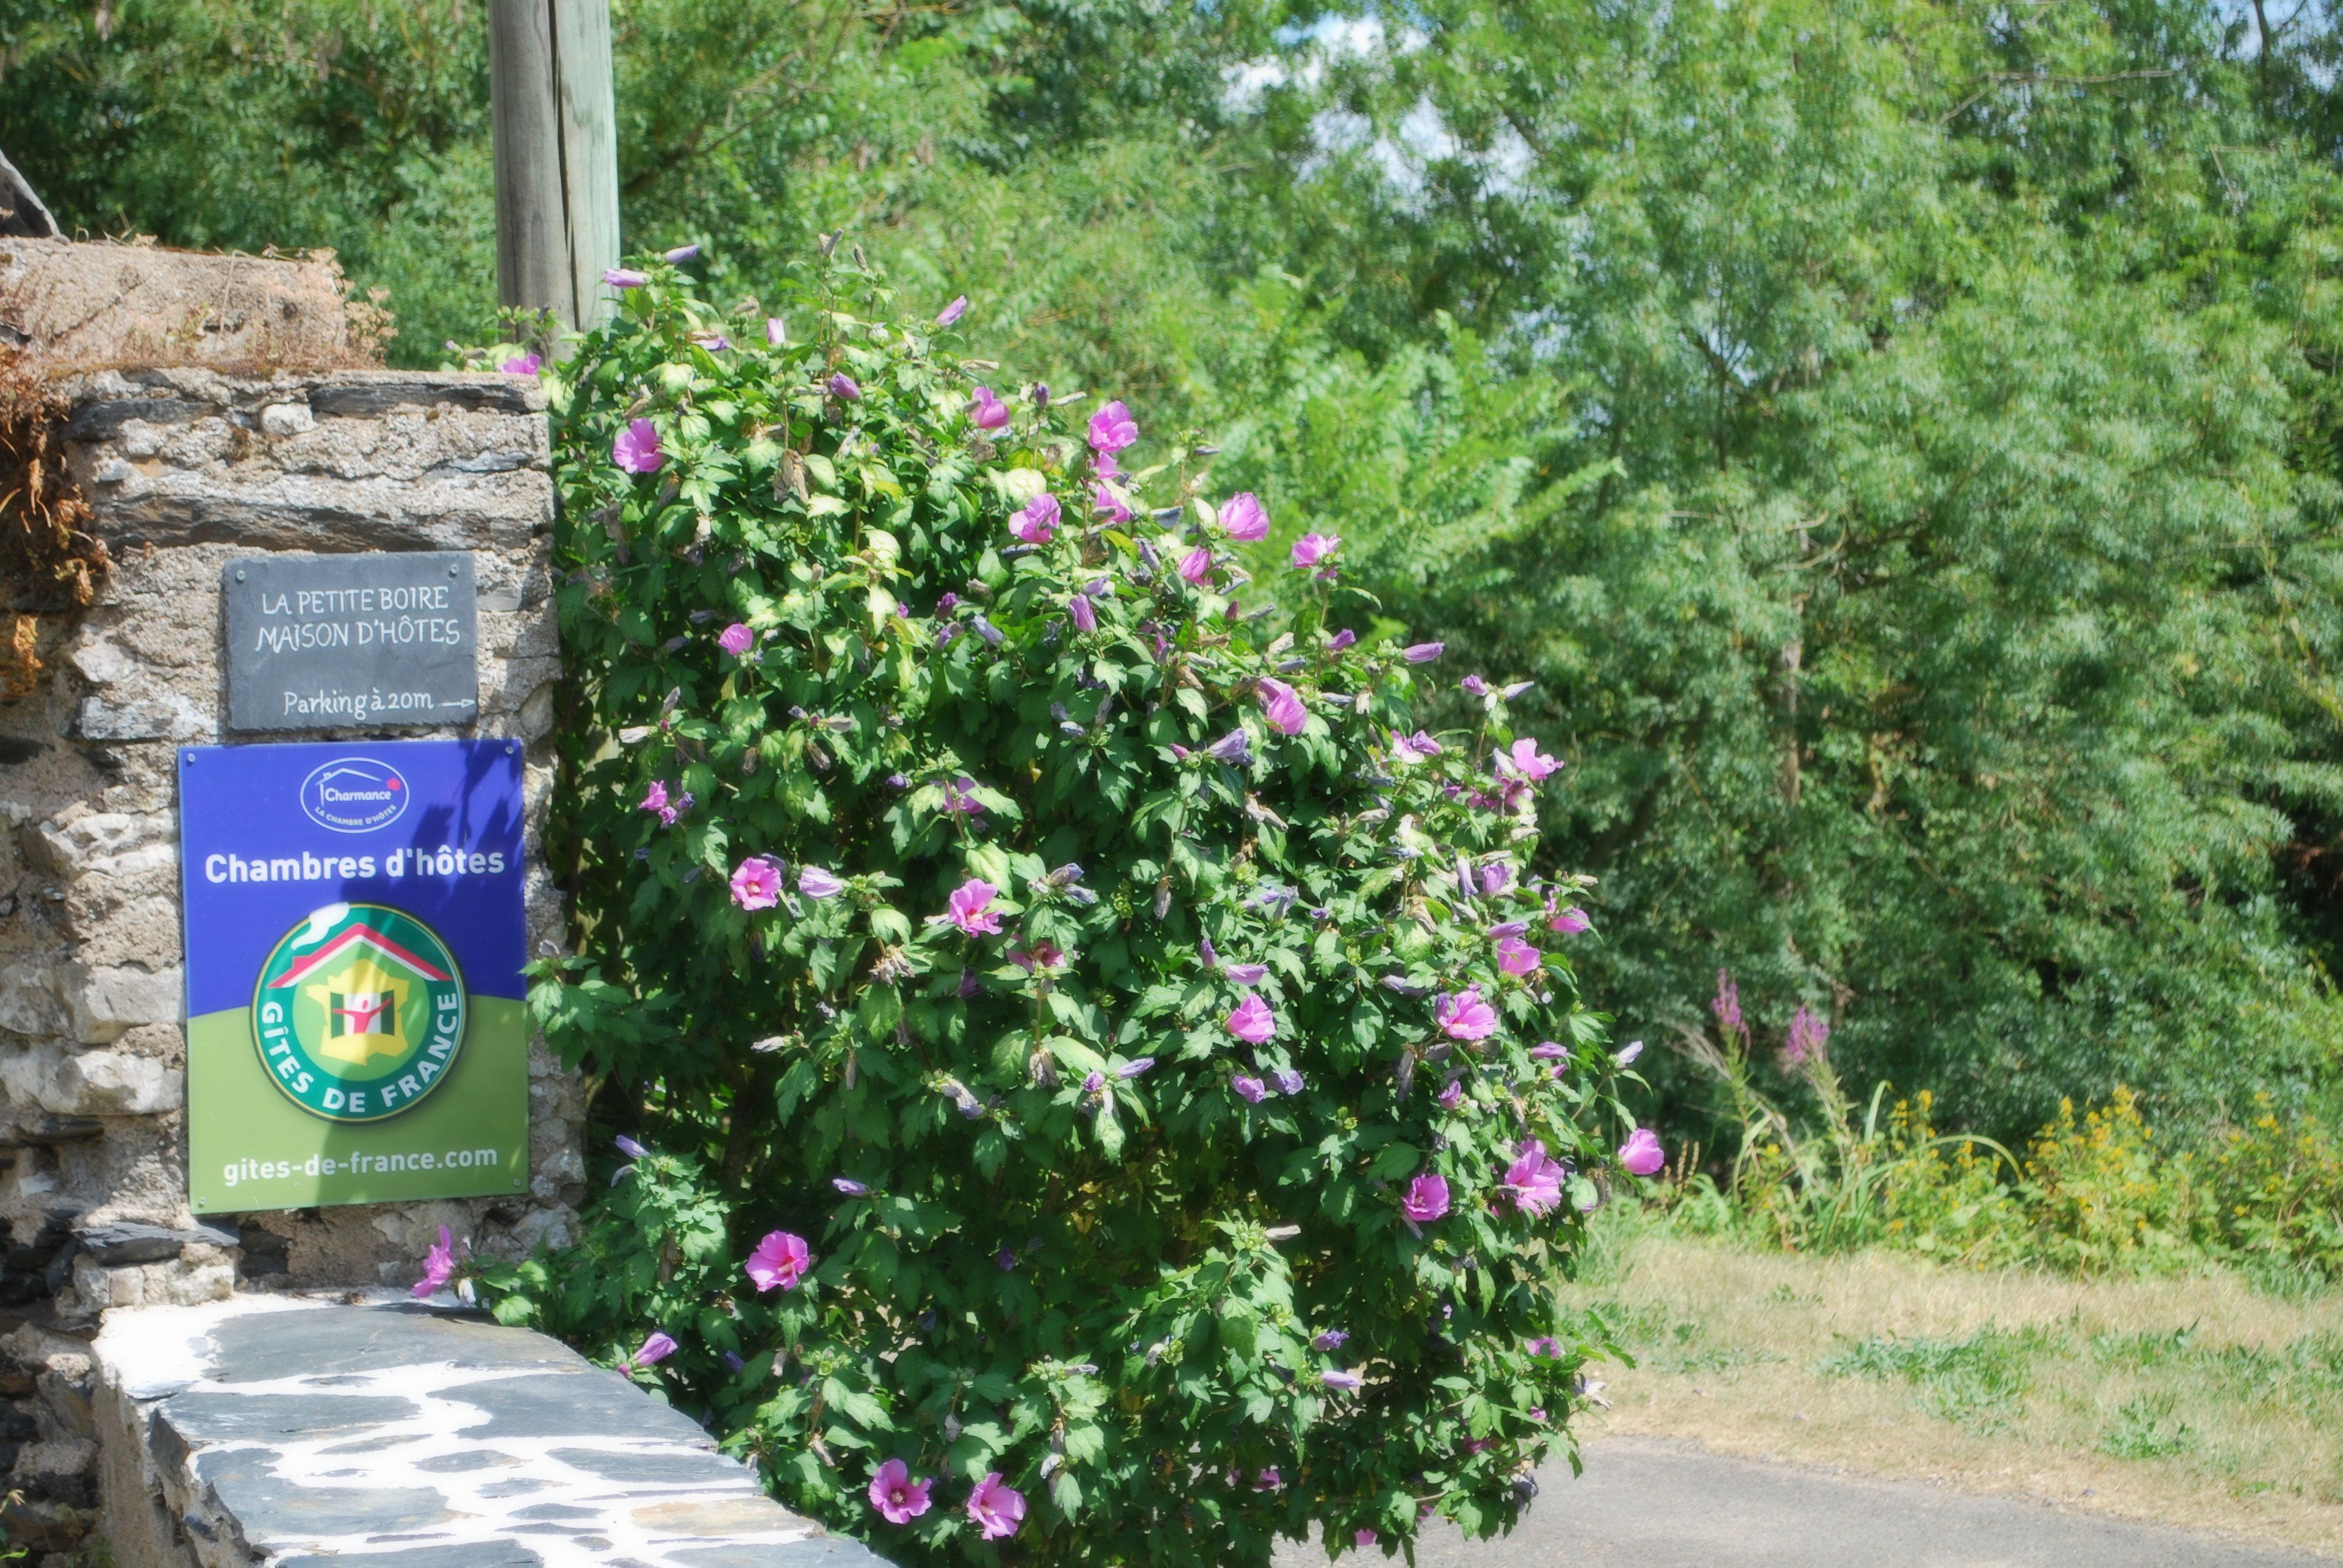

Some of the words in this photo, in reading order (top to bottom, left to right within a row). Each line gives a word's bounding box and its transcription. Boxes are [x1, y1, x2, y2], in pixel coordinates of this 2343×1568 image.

[262, 593, 292, 616] LA
[297, 588, 374, 614] PETITE
[378, 586, 448, 610] BOIRE
[254, 622, 348, 653] MAISON
[357, 615, 460, 645] D'HÔTES
[284, 689, 367, 721] Parking
[370, 687, 386, 711] à
[387, 691, 434, 710] 20m
[325, 787, 392, 802] Charmance
[315, 806, 325, 817] LA
[326, 813, 364, 826] CHAMBRE
[365, 804, 397, 825] D'HÔTES
[205, 851, 376, 883] Chambres
[386, 844, 505, 877] d'hôtes
[261, 1001, 314, 1094] GÎTES
[322, 1087, 366, 1113] DE
[380, 992, 458, 1107] FRANCE
[223, 1148, 497, 1187] gites-de-france.com
